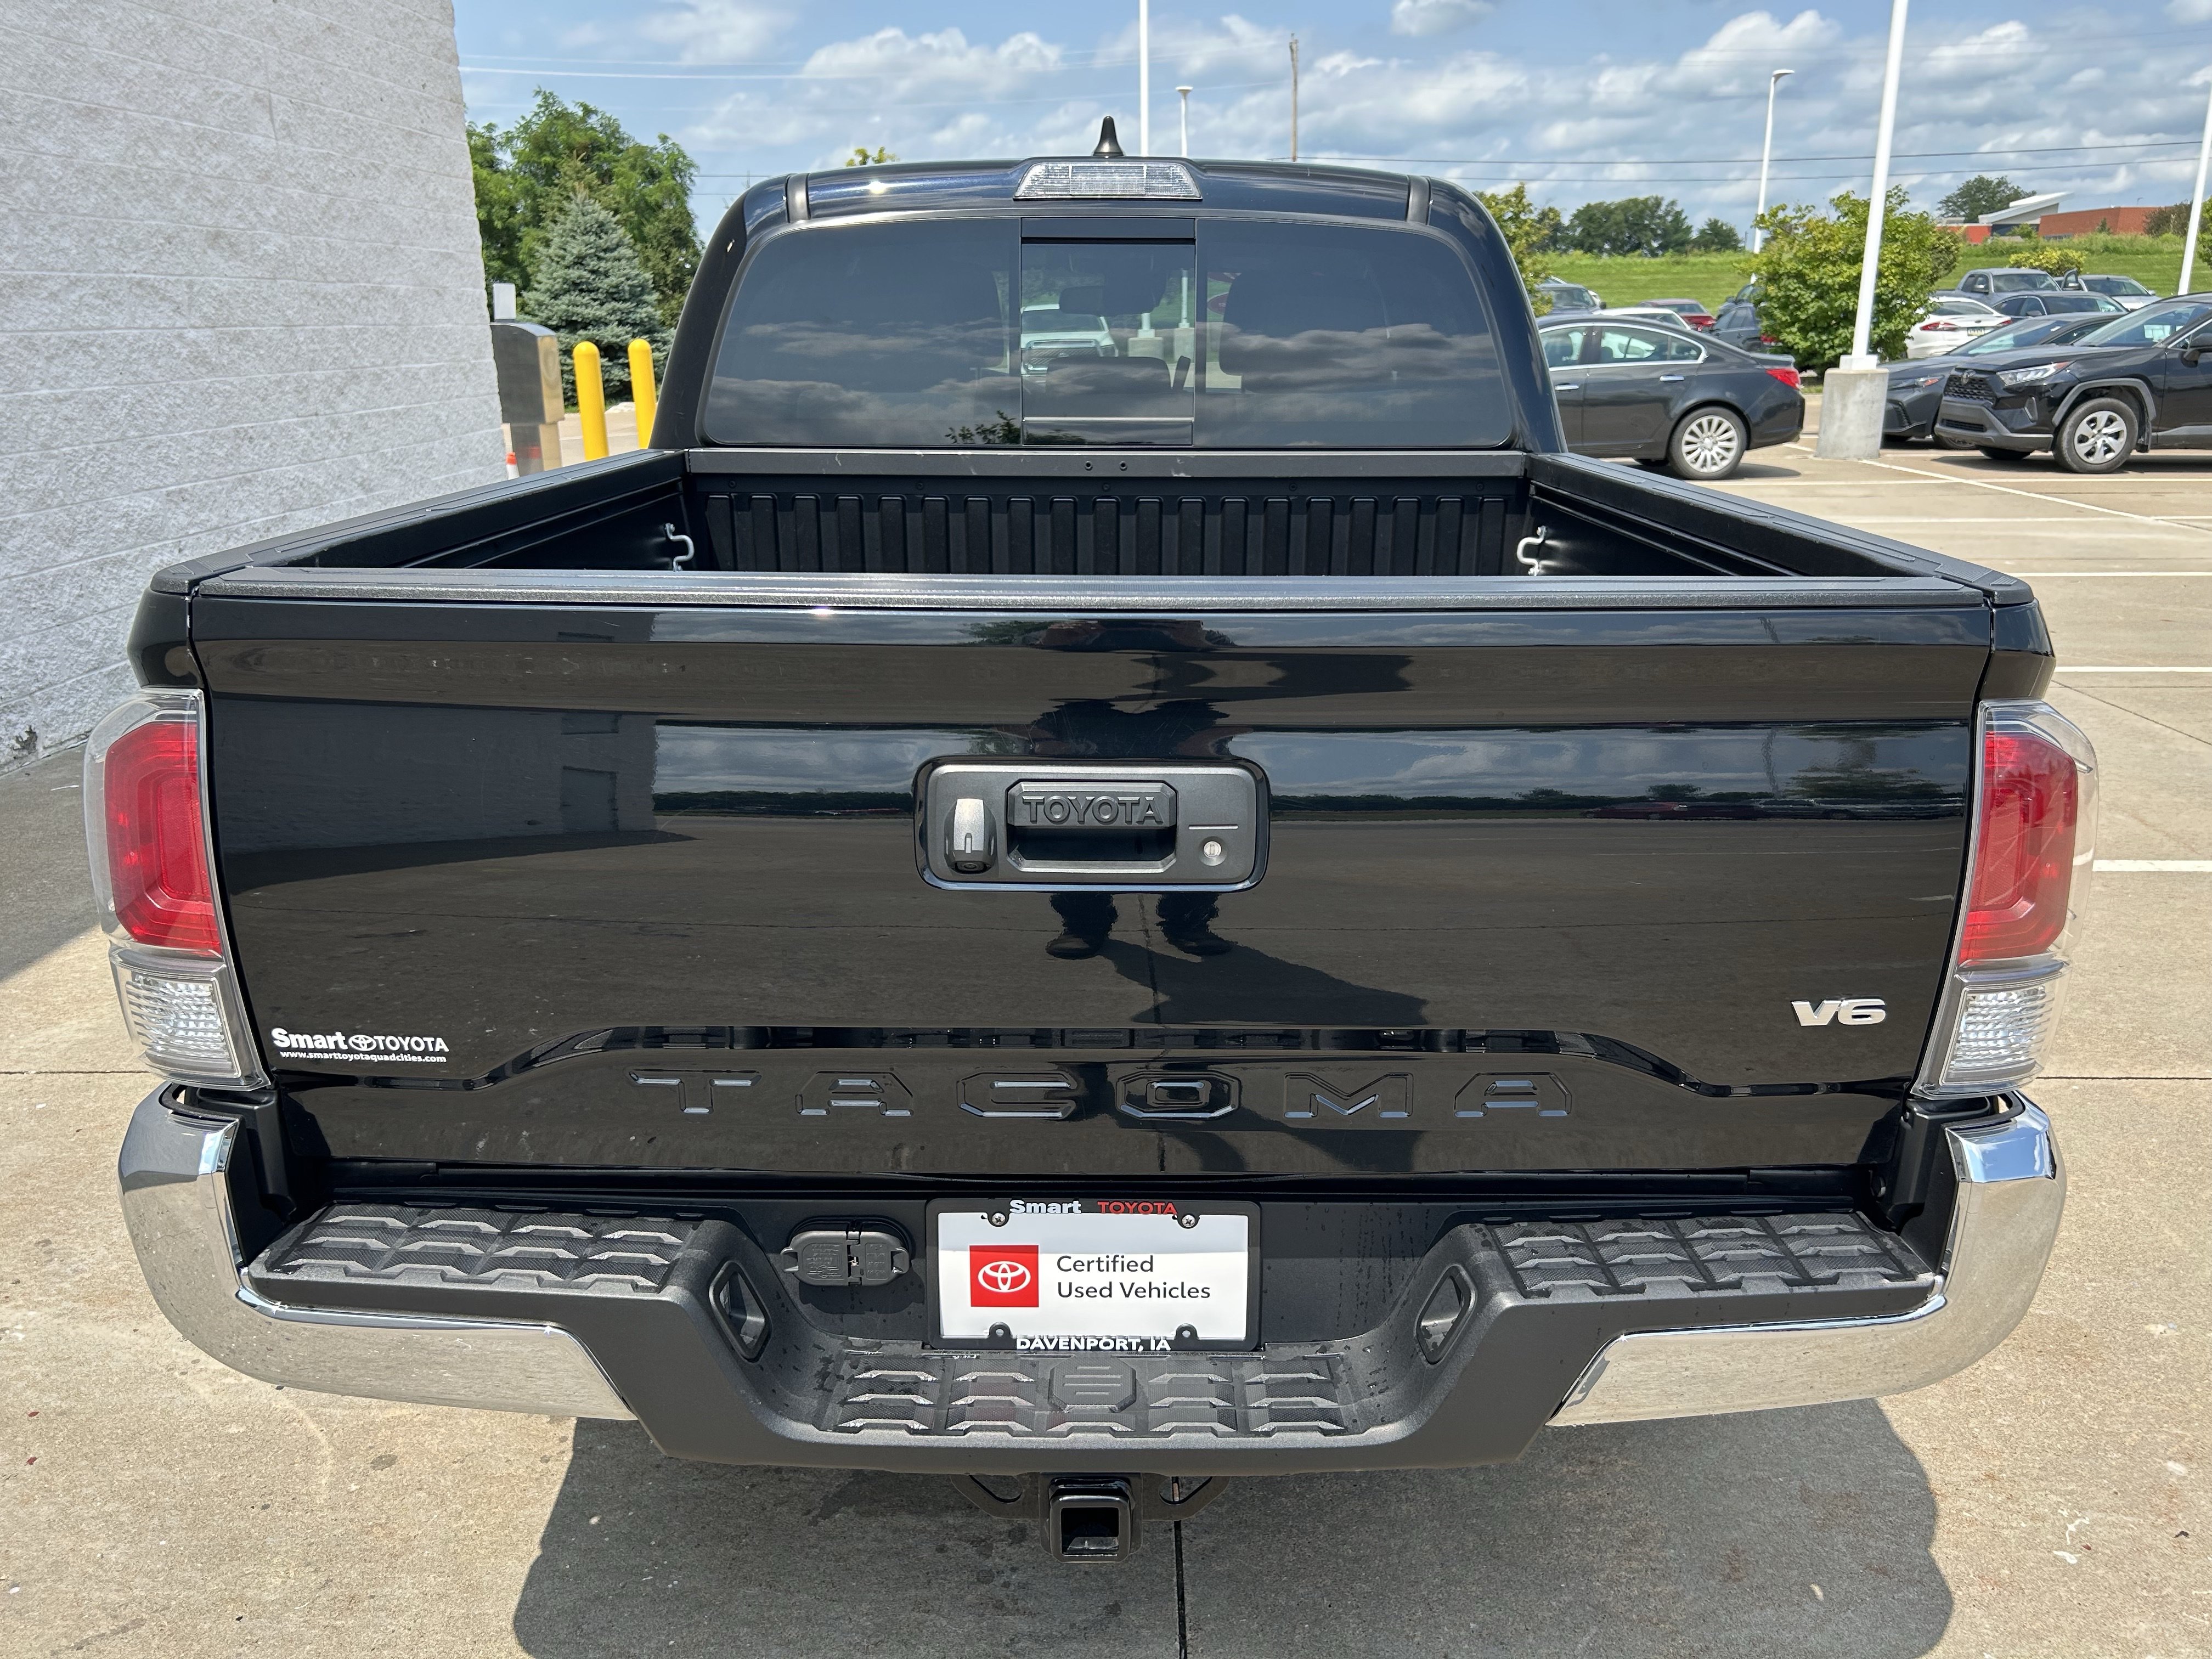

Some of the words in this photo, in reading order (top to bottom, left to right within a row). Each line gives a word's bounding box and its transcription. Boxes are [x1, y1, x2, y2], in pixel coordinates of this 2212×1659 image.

[1022, 795, 1164, 825] TOYOTA
[1791, 998, 1886, 1026] V6
[271, 1028, 348, 1049] Smart
[374, 1036, 449, 1052] TOYOTA
[280, 1051, 448, 1063] www.smarttoyotaquadcities.com
[629, 1069, 1572, 1119] TACOMA
[1009, 1199, 1082, 1214] Smart
[1097, 1201, 1178, 1215] TOYOTA
[1057, 1255, 1154, 1273] Certified
[1058, 1282, 1113, 1299] Used
[1120, 1282, 1210, 1299] Vehicles
[1016, 1338, 1143, 1352] DAVENPORT,
[1150, 1338, 1171, 1351] IA
